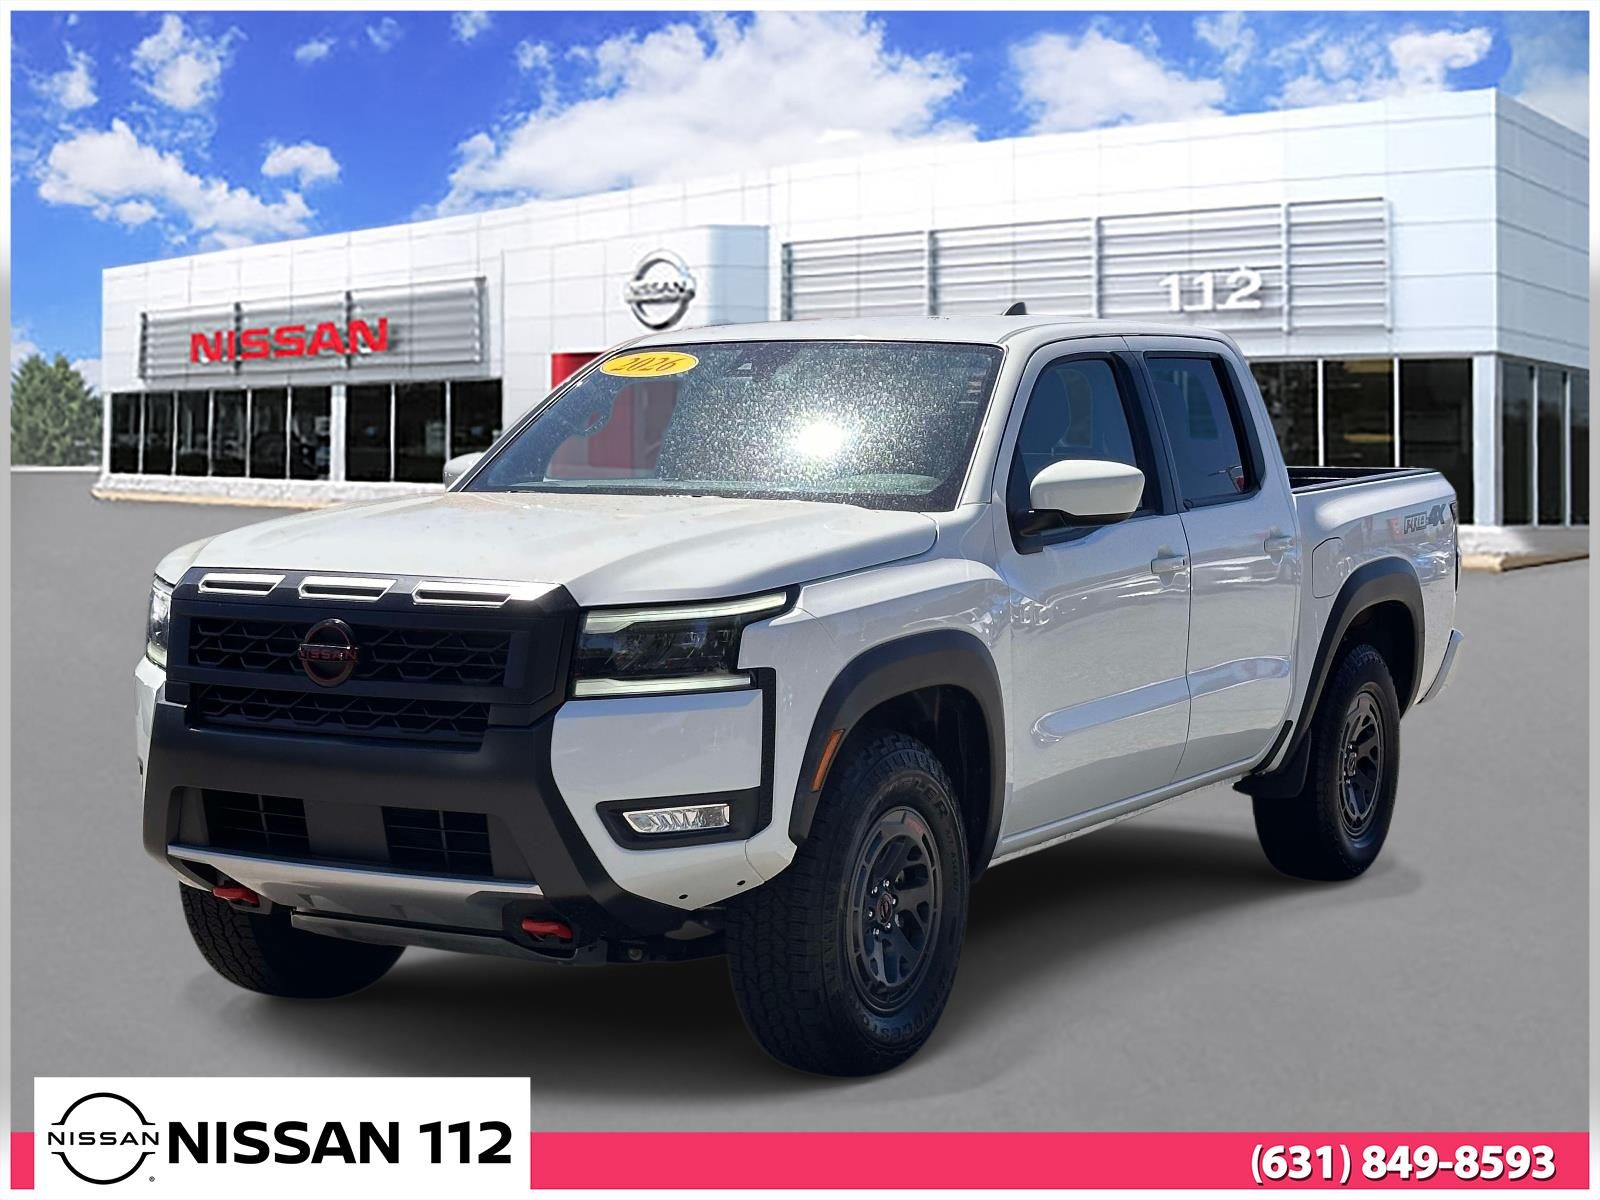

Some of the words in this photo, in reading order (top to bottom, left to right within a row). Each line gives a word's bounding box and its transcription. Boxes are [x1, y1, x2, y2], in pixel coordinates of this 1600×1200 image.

[627, 281, 690, 298] NISSAN
[1159, 269, 1262, 312] 112
[190, 317, 389, 363] NISSAN
[610, 357, 686, 372] 2026
[299, 648, 357, 661] NISSAN
